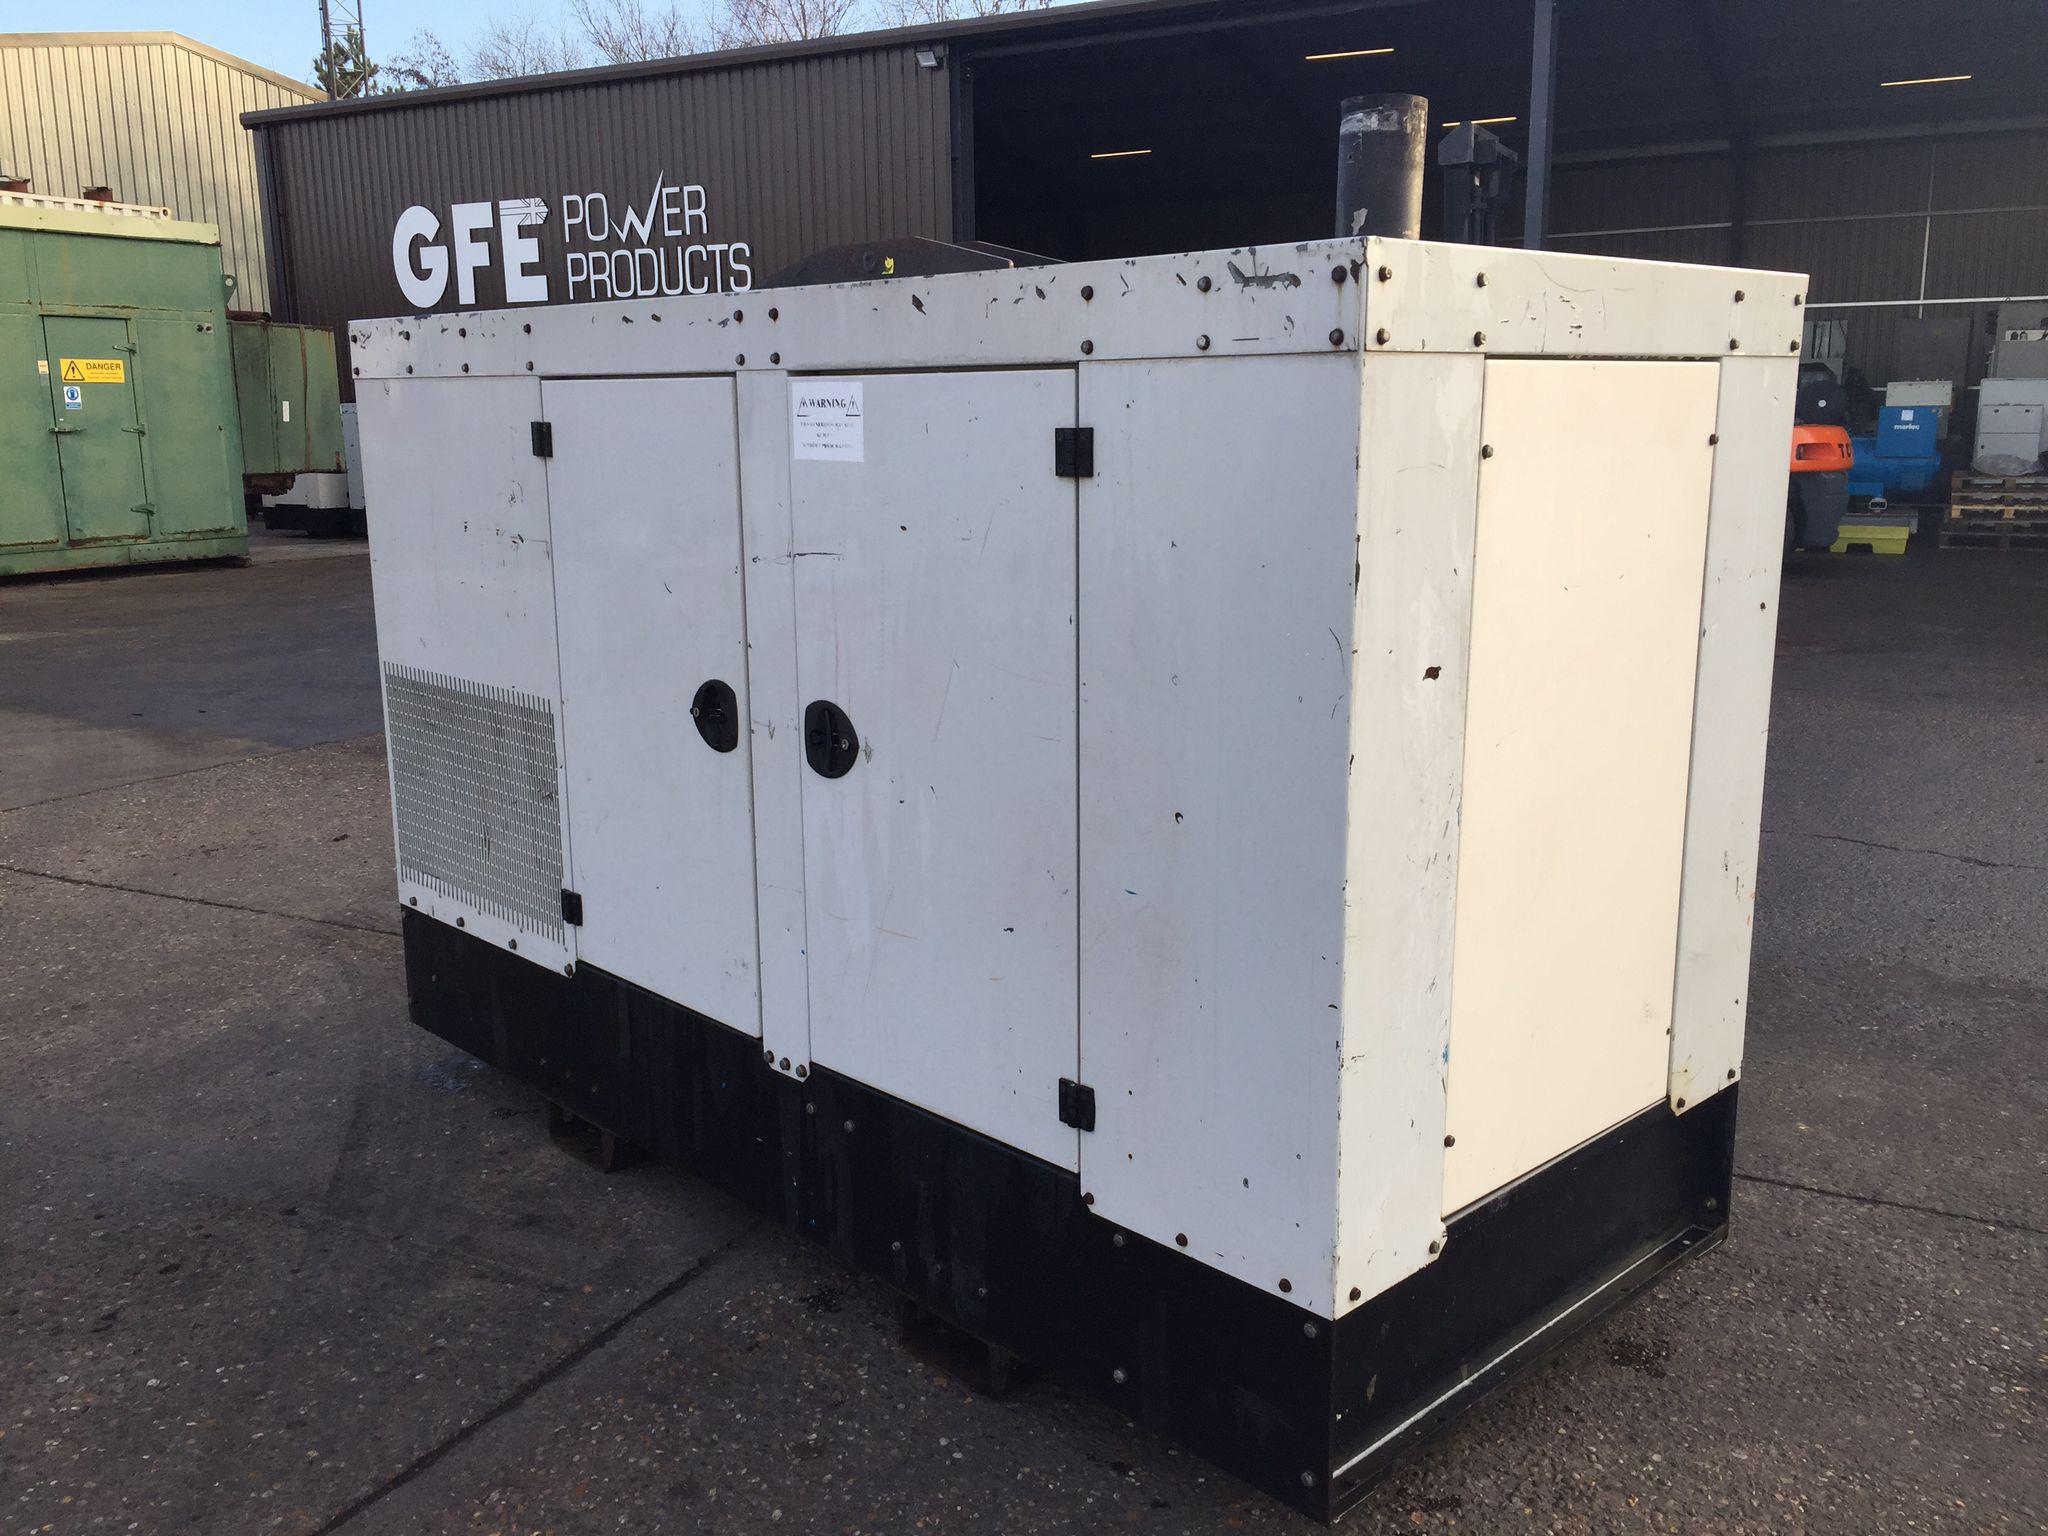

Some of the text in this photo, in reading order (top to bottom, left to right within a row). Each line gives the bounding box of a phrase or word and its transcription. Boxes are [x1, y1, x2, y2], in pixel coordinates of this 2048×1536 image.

[562, 169, 708, 246] POWER
[393, 197, 549, 309] GFE
[567, 242, 752, 300] PRODUCTS
[86, 362, 122, 371] DANGER
[808, 398, 847, 409] WARNING
